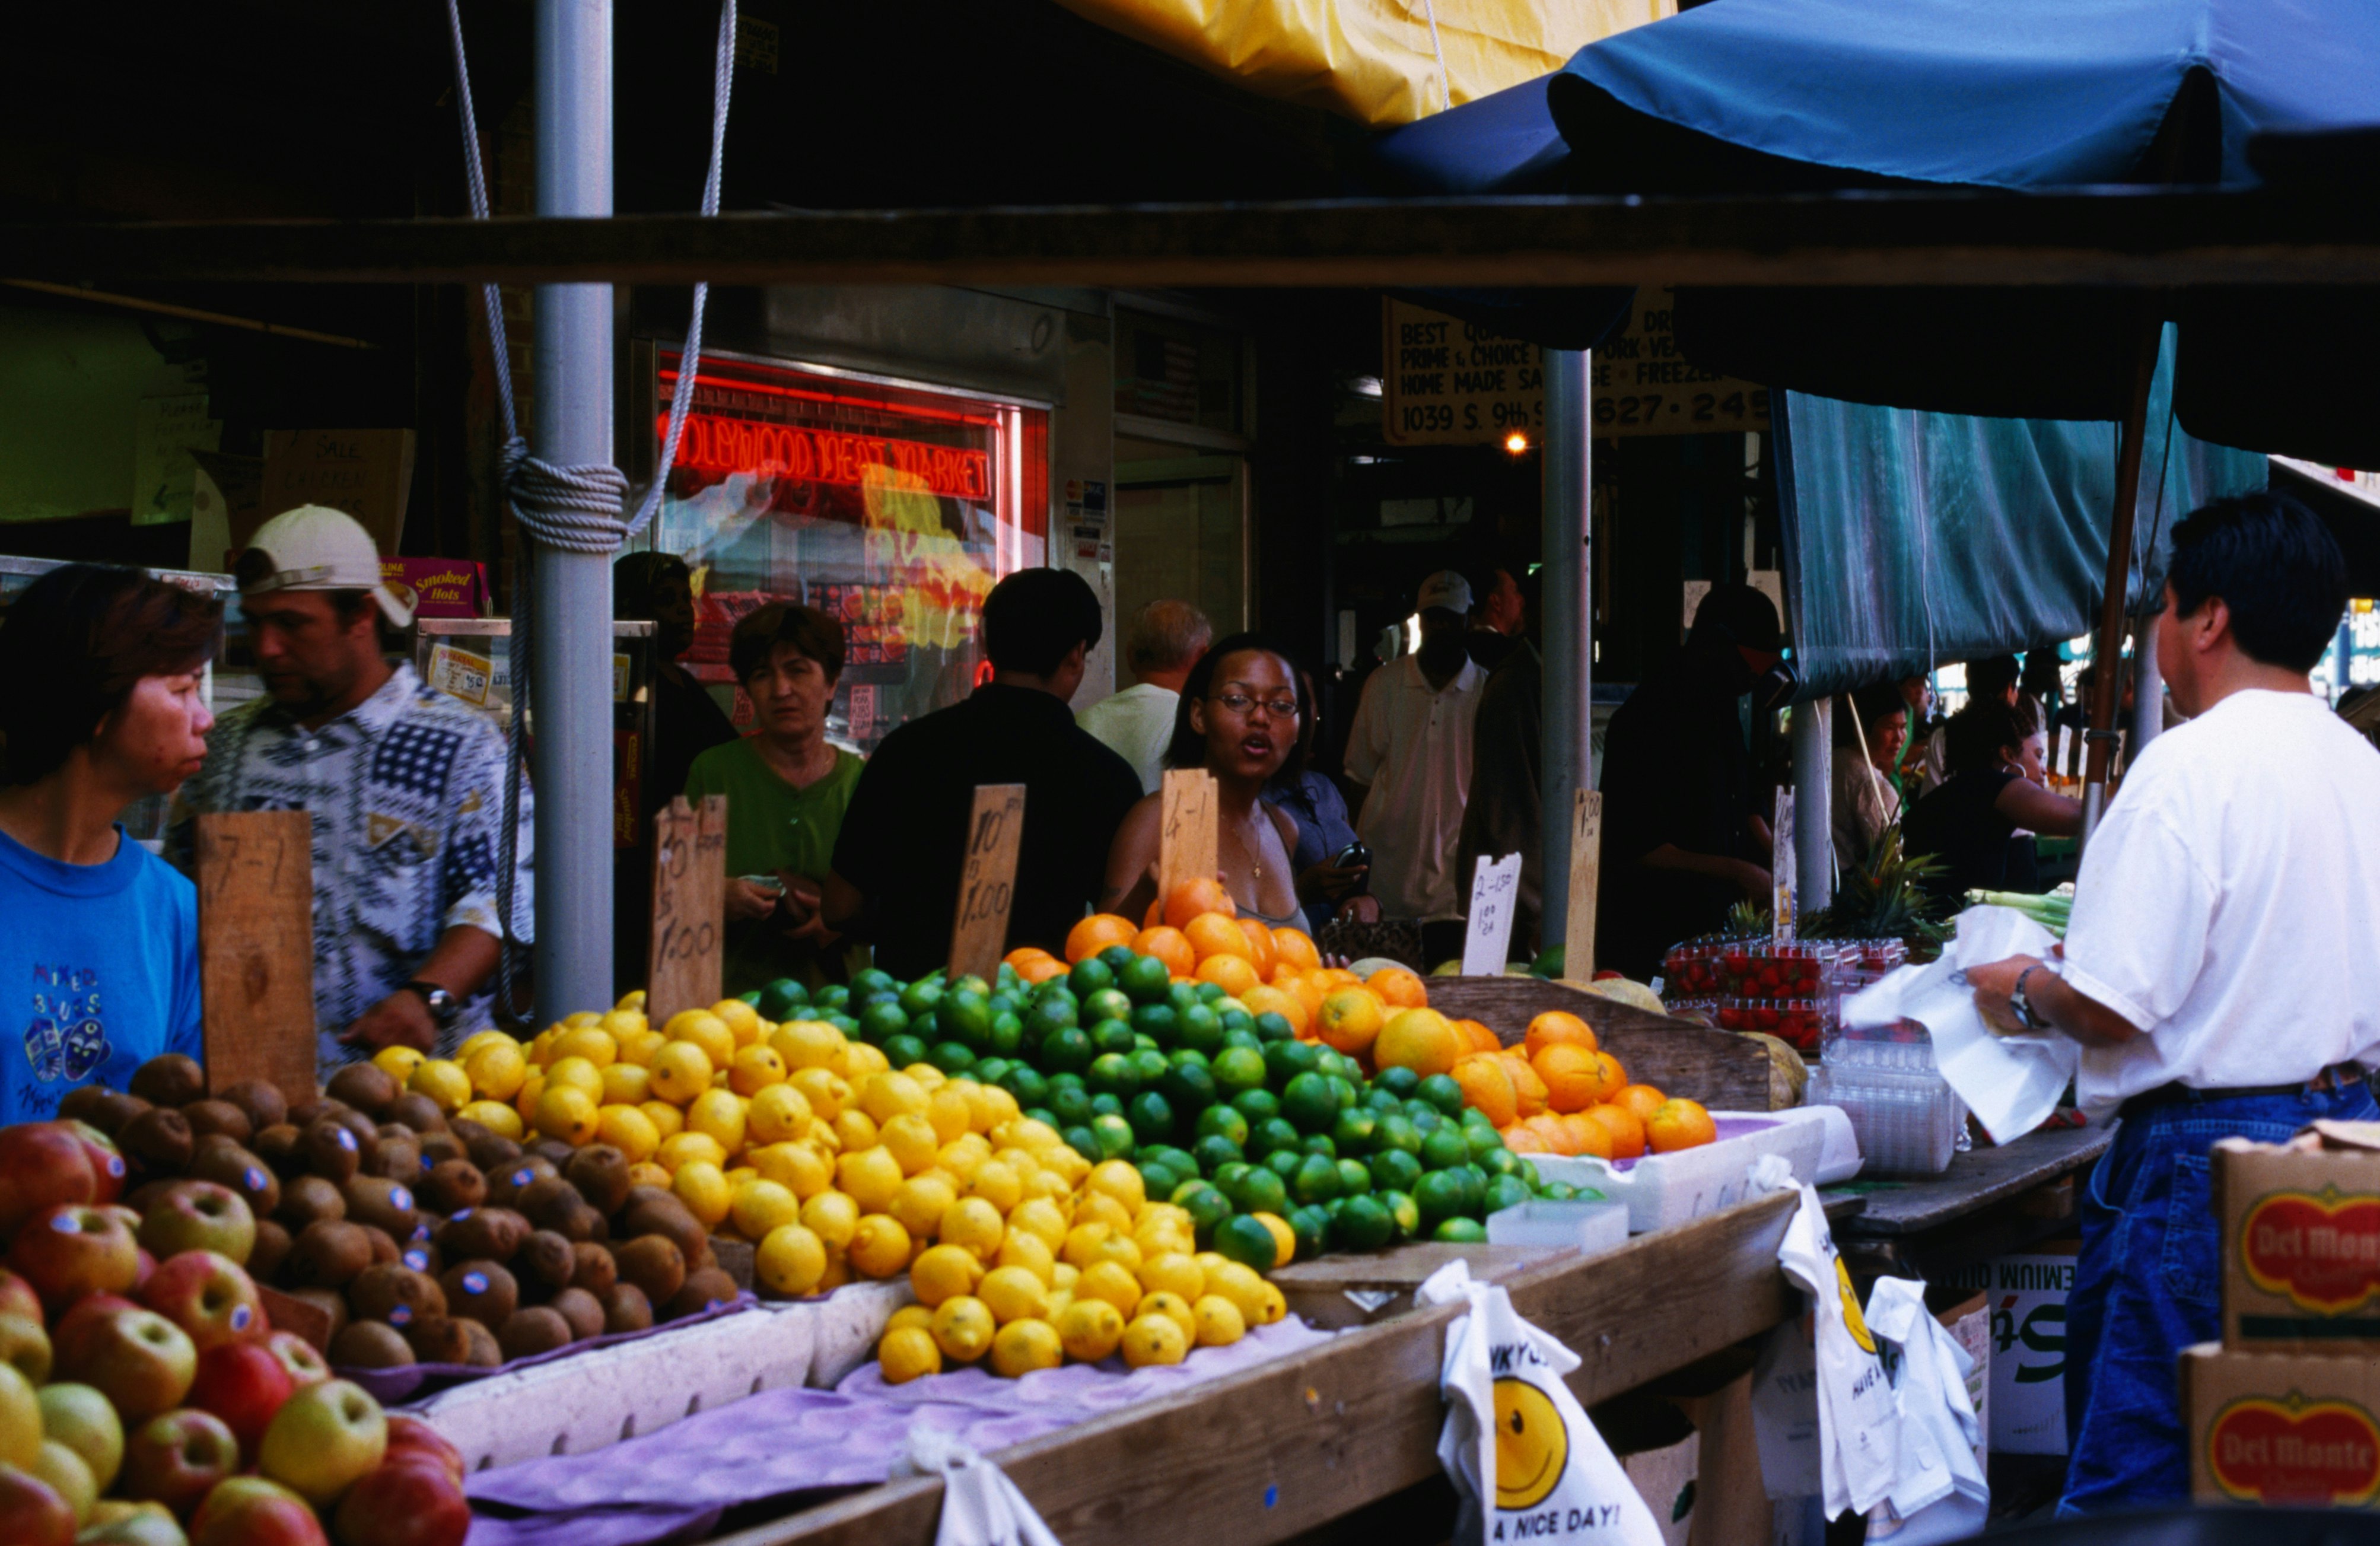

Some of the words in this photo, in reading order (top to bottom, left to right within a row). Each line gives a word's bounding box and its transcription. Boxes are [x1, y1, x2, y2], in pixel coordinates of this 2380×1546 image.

[1401, 322, 1449, 345] BEST
[1401, 346, 1449, 369] PRIME
[1471, 342, 1529, 366] CHOICE
[1402, 373, 1443, 395] HOME
[1455, 370, 1506, 393] MADE
[1404, 405, 1453, 431] 1039
[1493, 402, 1528, 428] 9th
[315, 434, 361, 459] SALE
[284, 469, 367, 489] CHICKEN
[817, 434, 885, 483] MEAT
[892, 443, 985, 495] MARKET
[415, 570, 471, 593] Smoked
[431, 588, 460, 601] Hots
[971, 809, 1003, 855] 10
[960, 881, 1009, 930] 1.00
[657, 917, 713, 972] 1.00
[34, 993, 101, 1022] BLUES
[2257, 1224, 2302, 1257] Del
[2223, 1433, 2270, 1466] Del
[2276, 1435, 2373, 1470] Monte
[1494, 1520, 1504, 1541] A
[1514, 1512, 1558, 1539] NICE
[1568, 1504, 1621, 1532] DAY!
